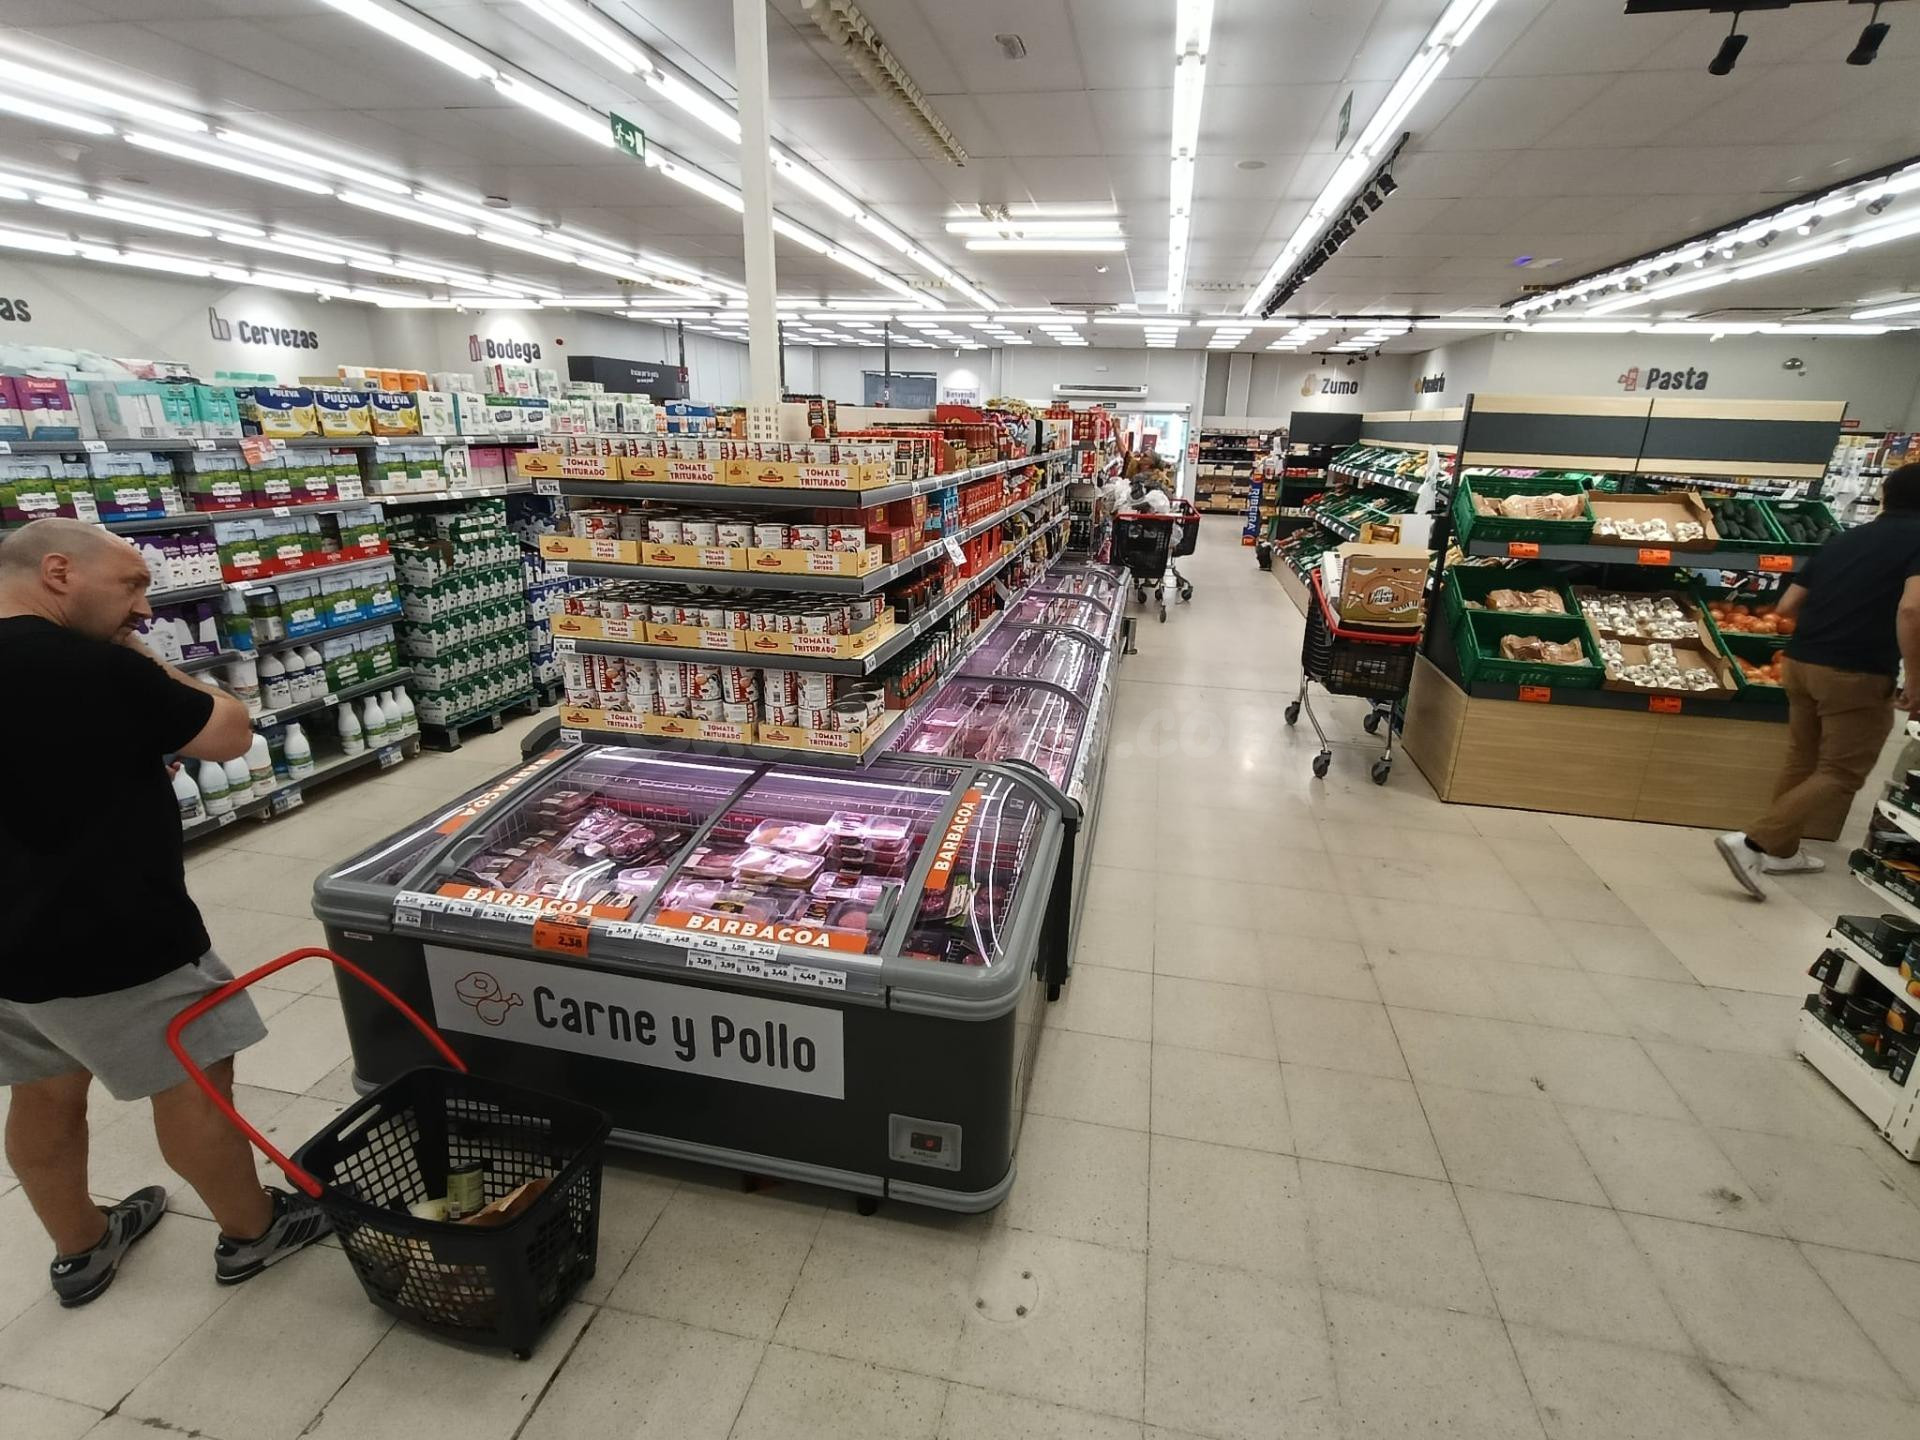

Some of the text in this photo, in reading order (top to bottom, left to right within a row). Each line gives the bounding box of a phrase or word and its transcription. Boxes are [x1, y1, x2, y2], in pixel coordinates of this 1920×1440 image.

[238, 320, 319, 350] Cervezas
[486, 338, 541, 363] Bodega
[1646, 366, 1709, 391] Pasta
[1321, 378, 1359, 396] Zumo
[269, 388, 300, 398] PULEVA
[884, 390, 890, 401] 3
[323, 392, 360, 404] PULEVA
[378, 394, 410, 405] PULEVA
[566, 458, 598, 467] TOMATE
[562, 467, 605, 476] TRITURADO
[674, 463, 707, 472] TOMATE
[670, 472, 714, 481] TRITURADO
[806, 468, 840, 477] TOMATE
[800, 478, 847, 487] TRITURADO
[798, 636, 831, 645] TOMATE
[793, 644, 837, 654] TRITURADO
[611, 713, 638, 722] TOMATE
[606, 721, 643, 729] TRITURADO
[707, 724, 735, 733] TOMATE
[703, 731, 741, 740] TRITURADO
[815, 732, 843, 741] TOMATE
[809, 739, 849, 748] TRITURADO
[460, 758, 551, 817] BARBACOA
[933, 802, 976, 871] BARBACOA
[462, 887, 594, 917] BARBACOA
[686, 915, 831, 948] BARBACOA
[558, 935, 583, 948] 2,38
[720, 961, 736, 970] 3,99
[746, 965, 761, 973] 1,99
[771, 968, 788, 977] 3,49
[799, 972, 817, 981] 4,49
[827, 976, 843, 985] 3,99
[533, 985, 816, 1073] Carne y Pollo
